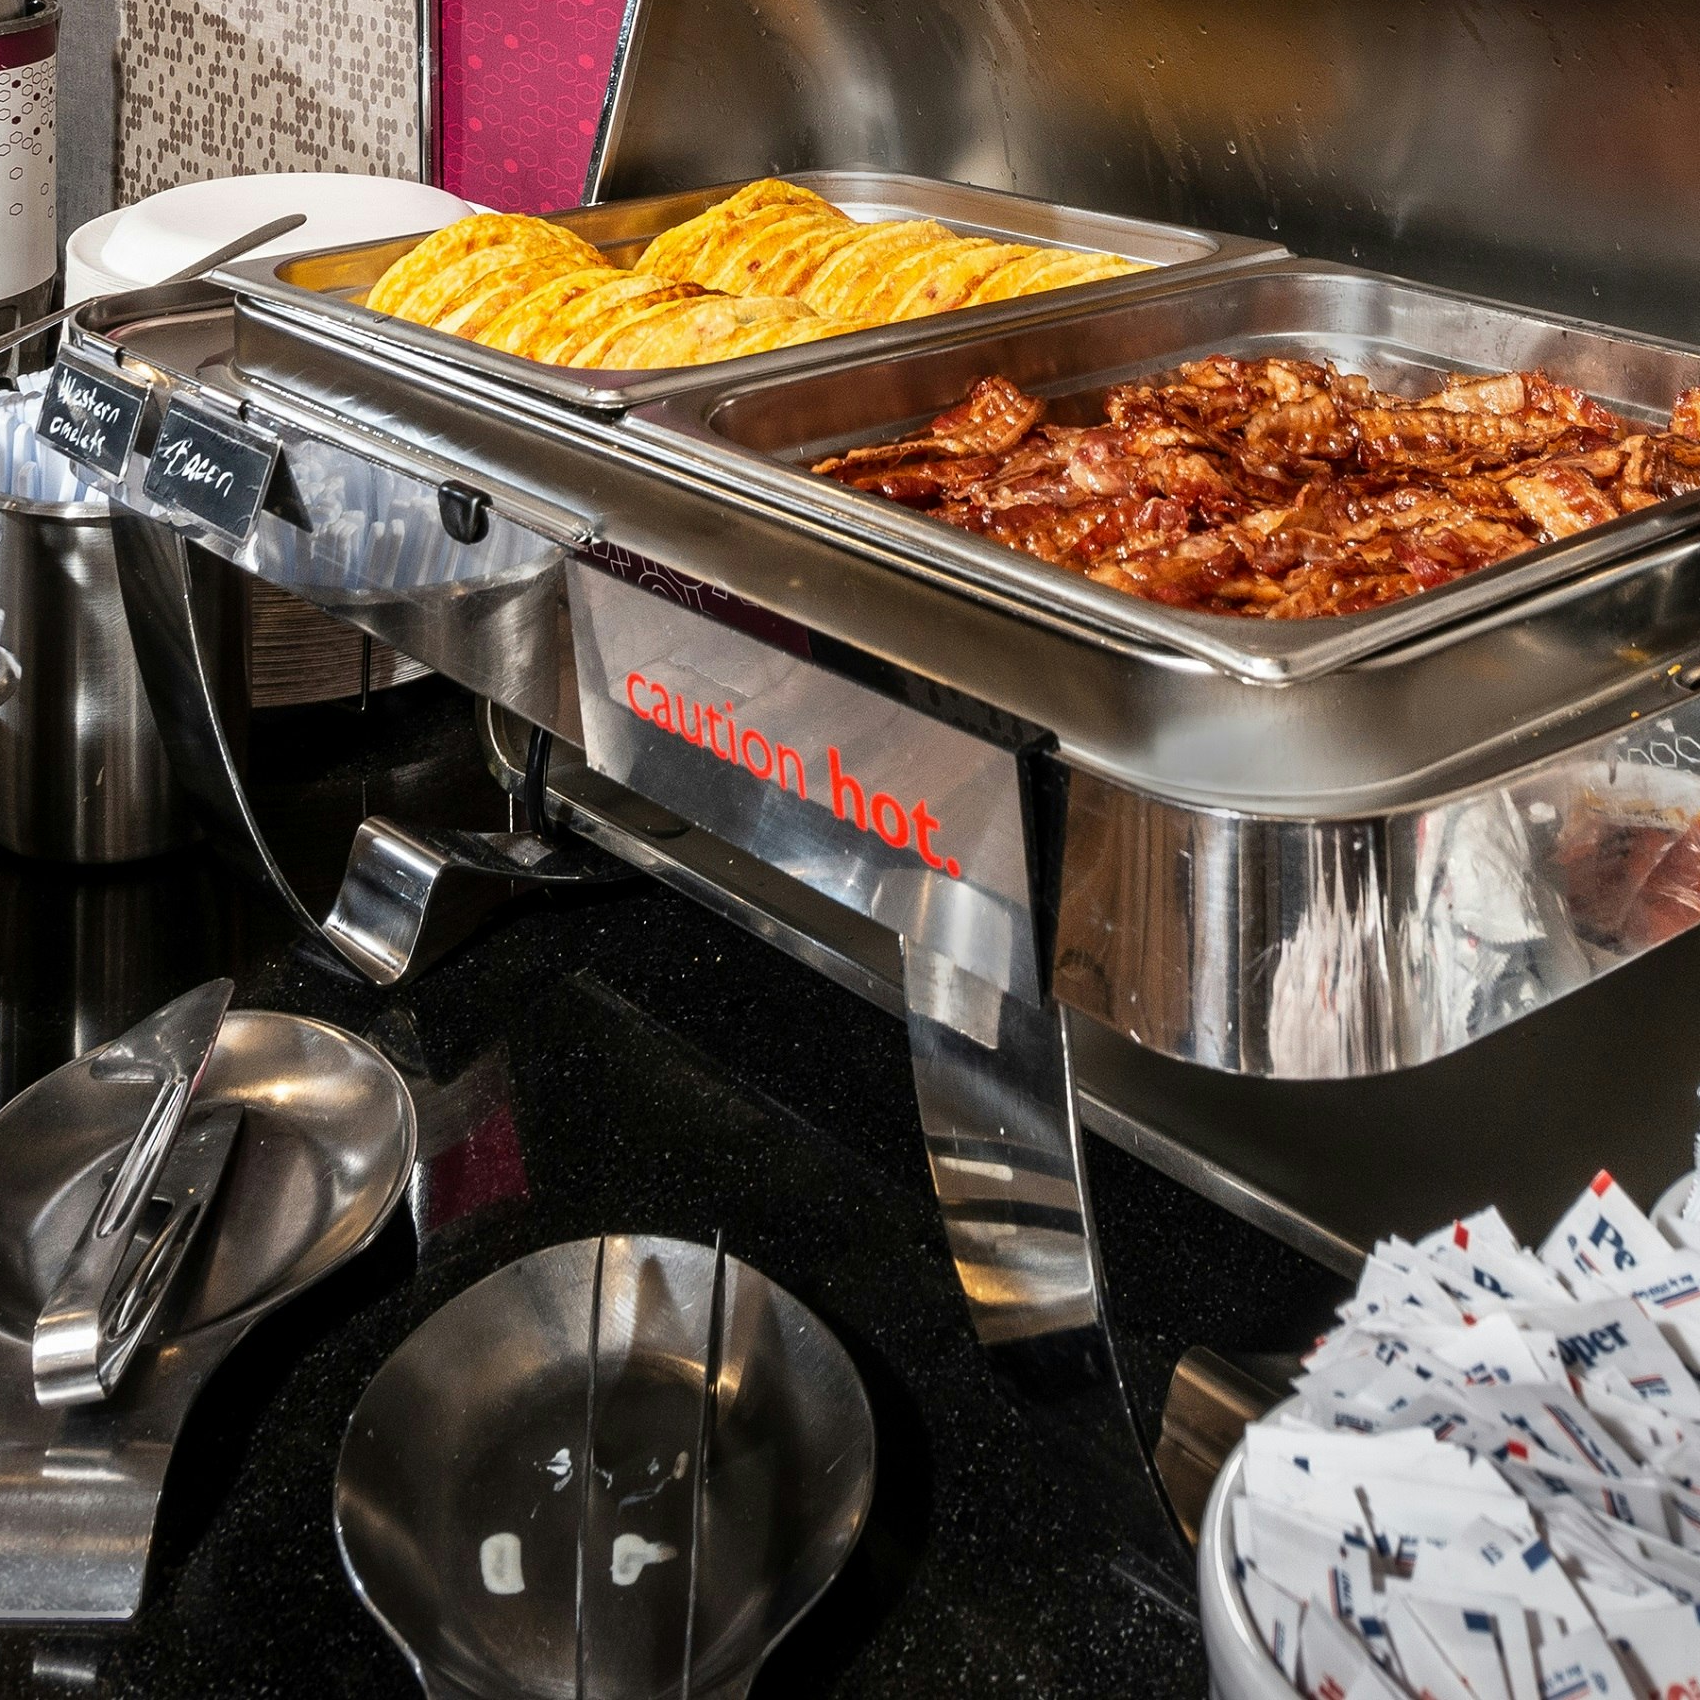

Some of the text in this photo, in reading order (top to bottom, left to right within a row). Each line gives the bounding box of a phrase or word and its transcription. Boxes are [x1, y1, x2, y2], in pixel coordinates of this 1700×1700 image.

[57, 367, 122, 425] Western
[49, 416, 106, 458] omelets
[625, 669, 963, 880] caution hot.
